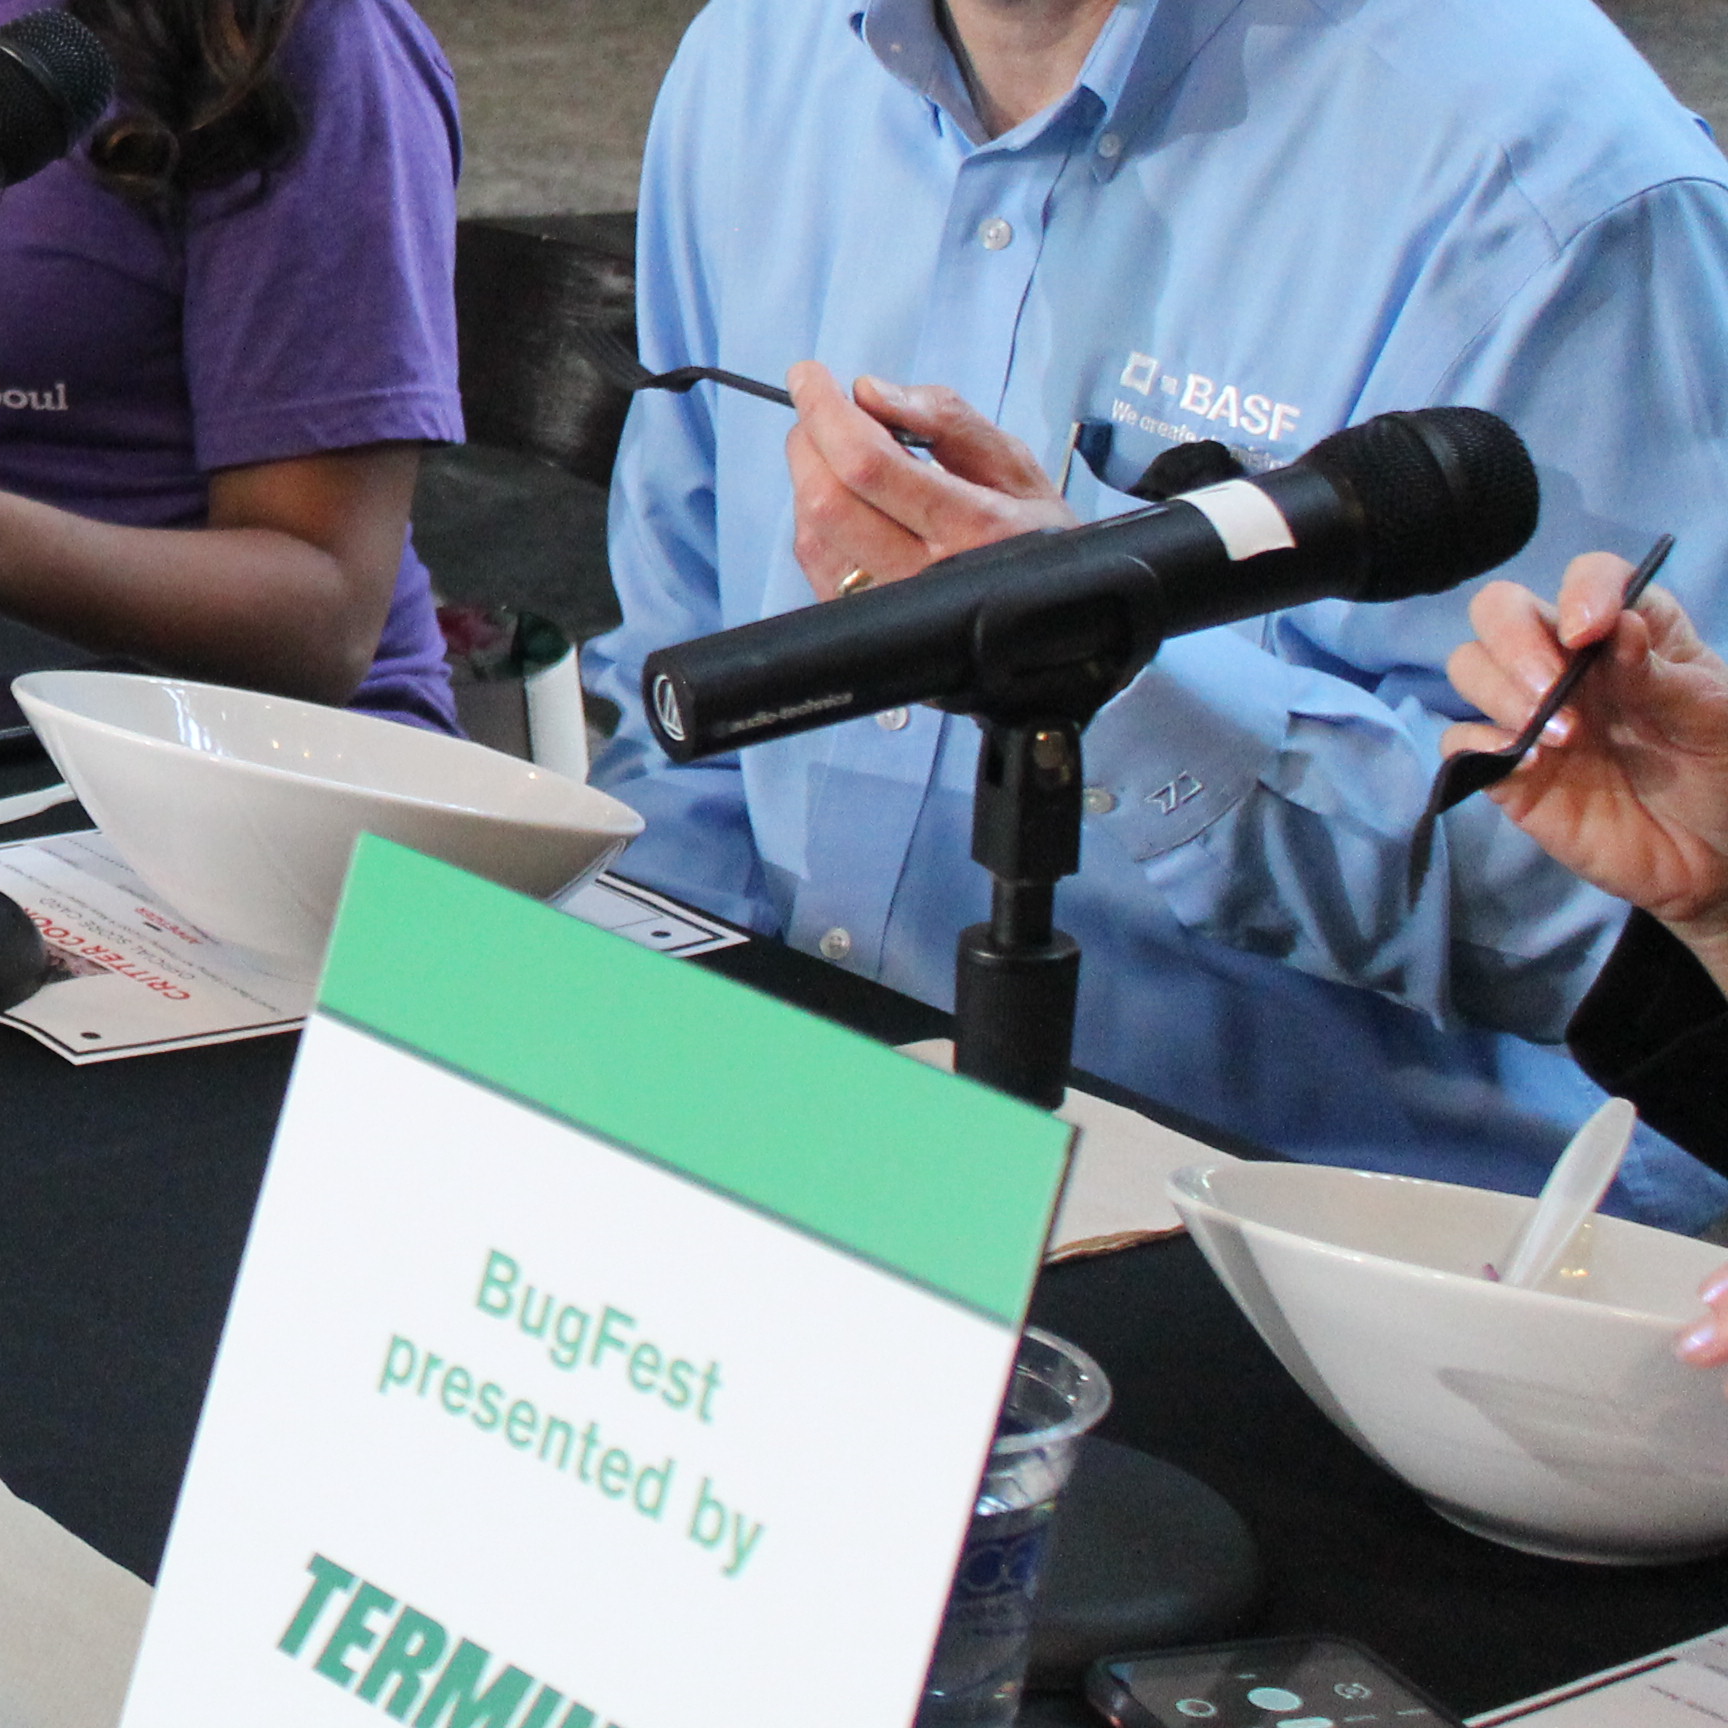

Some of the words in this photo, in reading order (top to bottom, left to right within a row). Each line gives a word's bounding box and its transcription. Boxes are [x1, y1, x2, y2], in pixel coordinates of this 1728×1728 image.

[1111, 397, 1139, 427] We
[1139, 415, 1198, 443] create
[1179, 373, 1302, 442] BASF
[80, 943, 191, 1001] CRITTER
[474, 1247, 724, 1425] BugFest
[375, 1332, 678, 1525] presented
[686, 1474, 766, 1580] by
[276, 1551, 631, 1728] TERM
